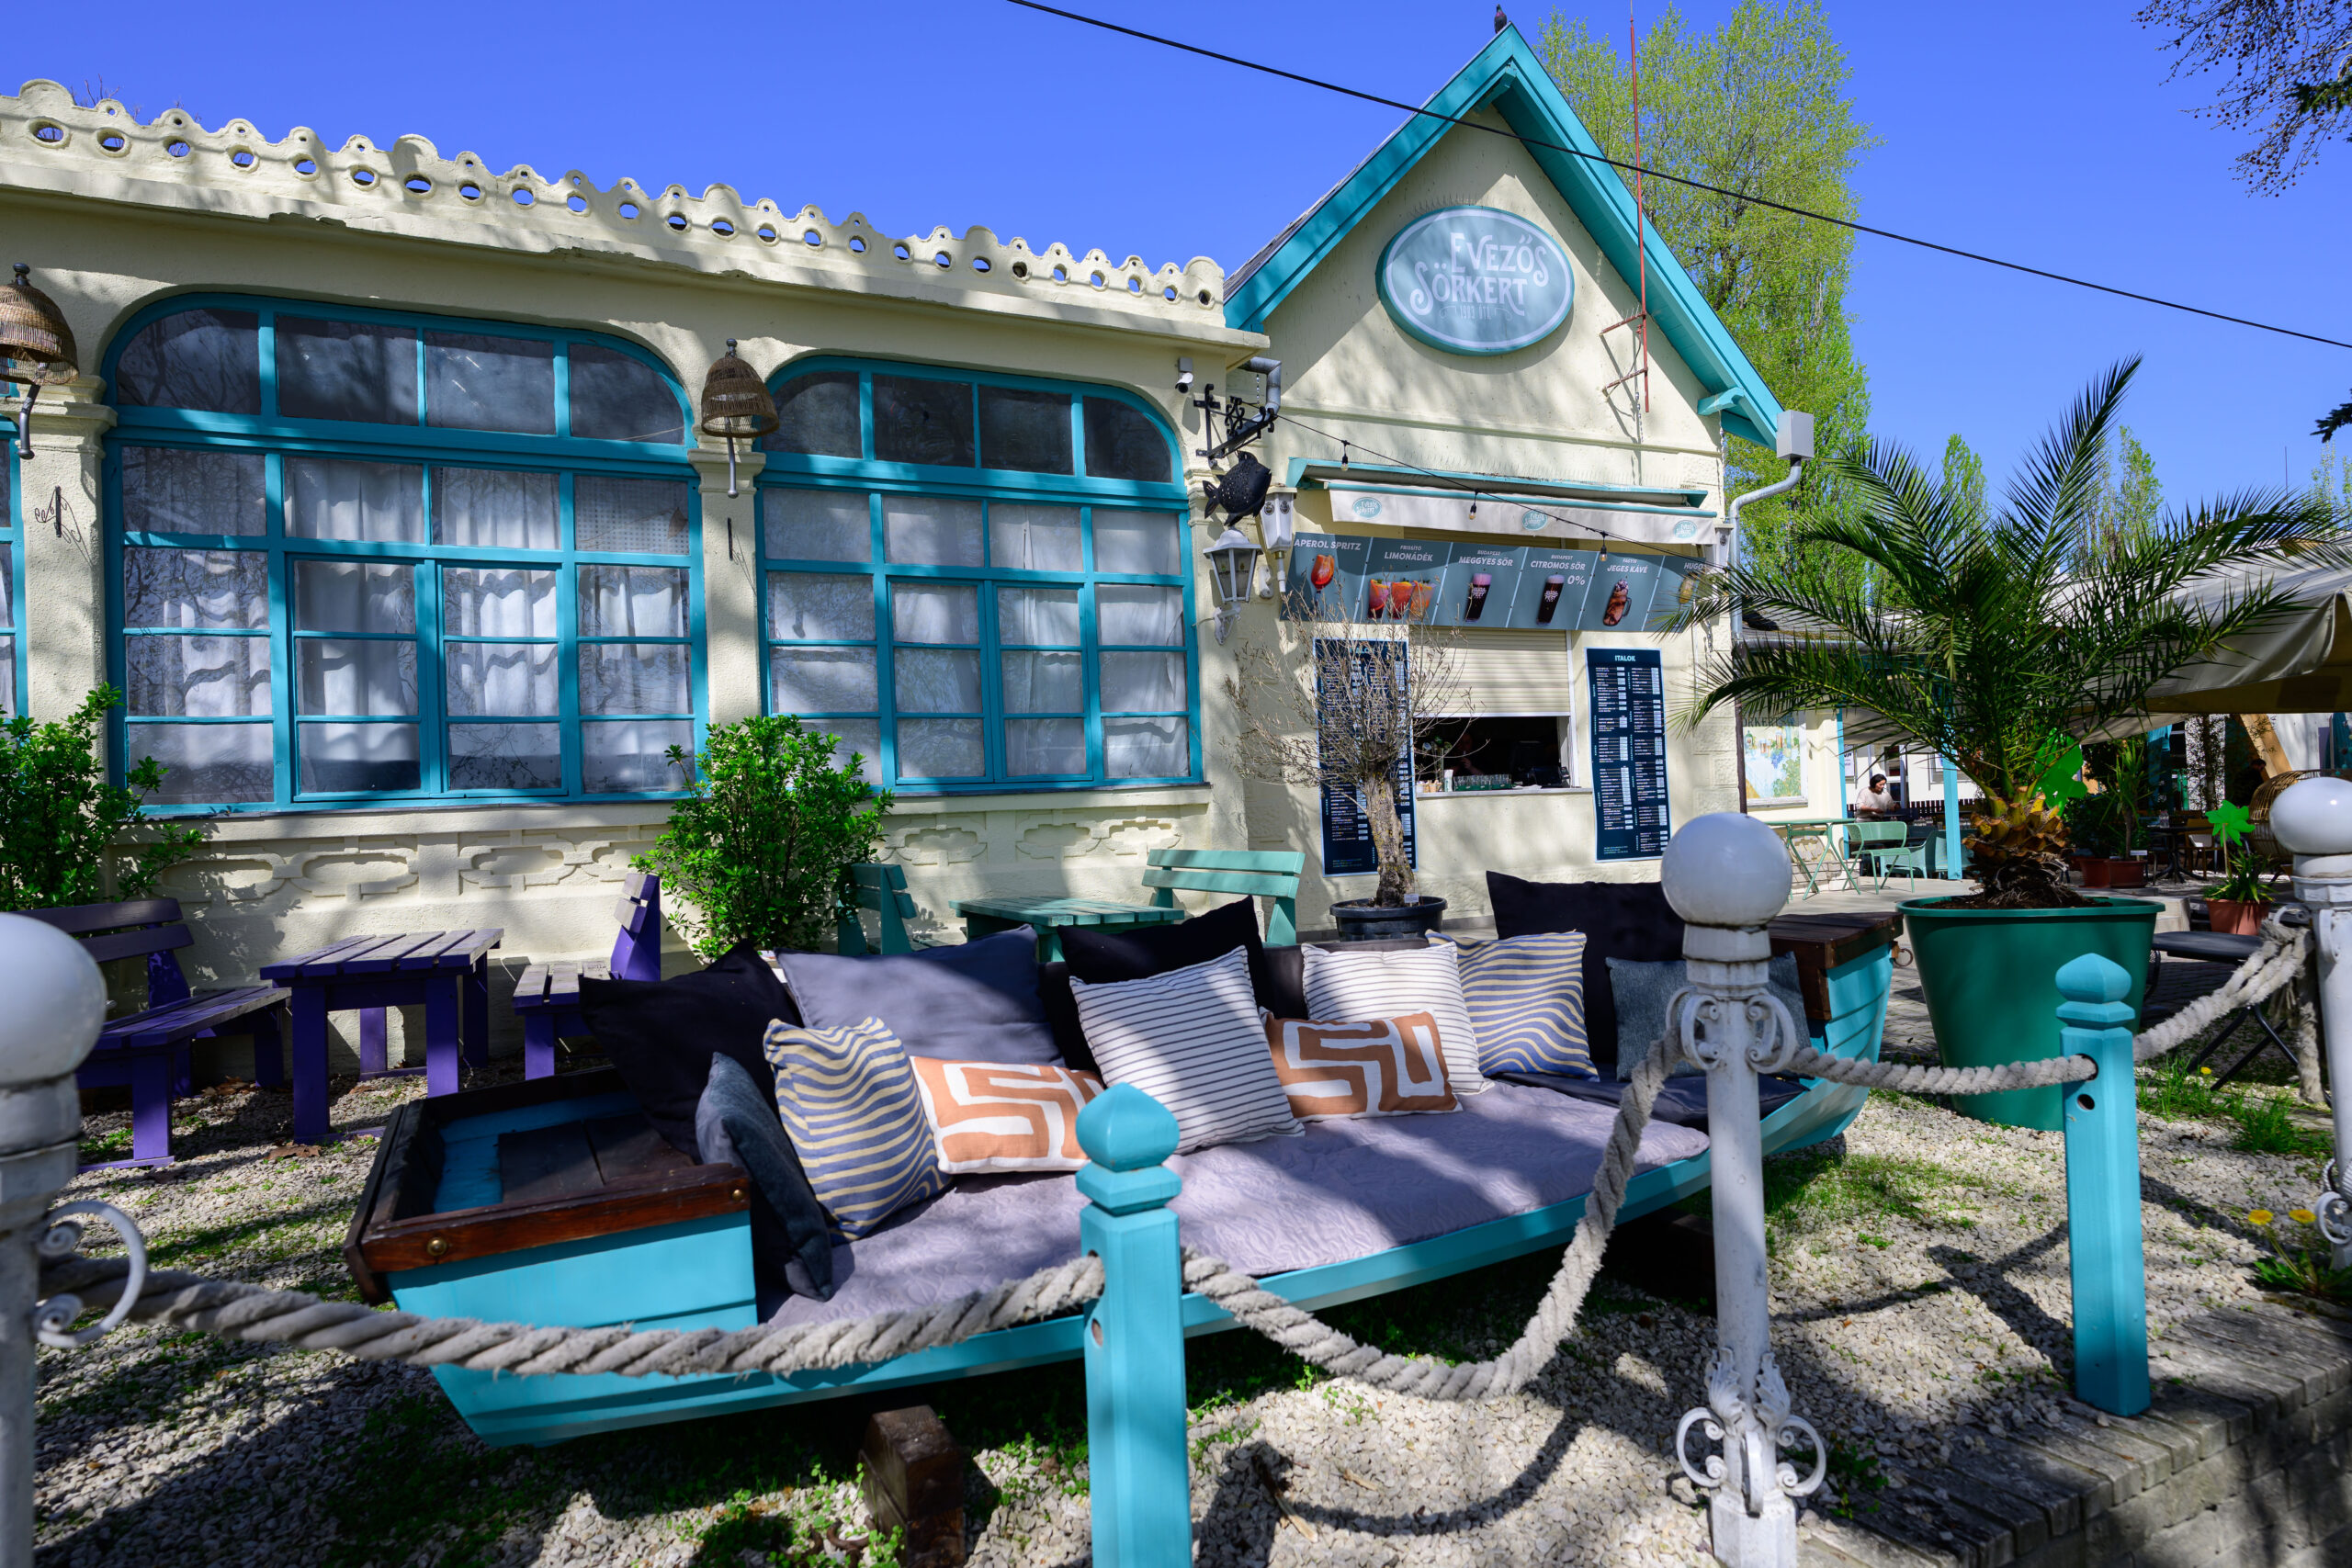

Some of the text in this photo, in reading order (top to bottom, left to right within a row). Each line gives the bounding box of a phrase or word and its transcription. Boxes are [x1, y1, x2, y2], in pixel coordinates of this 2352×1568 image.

[1409, 261, 1529, 317] SÖRKERT
[1294, 538, 1362, 551] APEROL SPRITZ
[1384, 551, 1433, 562] LIMONÁDÉK
[1458, 556, 1514, 567] MEGGYES SÖR
[1530, 560, 1586, 570] CITROMOS SÖR
[1607, 564, 1649, 574] JEGES KÁVÉ
[1566, 575, 1586, 586] 0%
